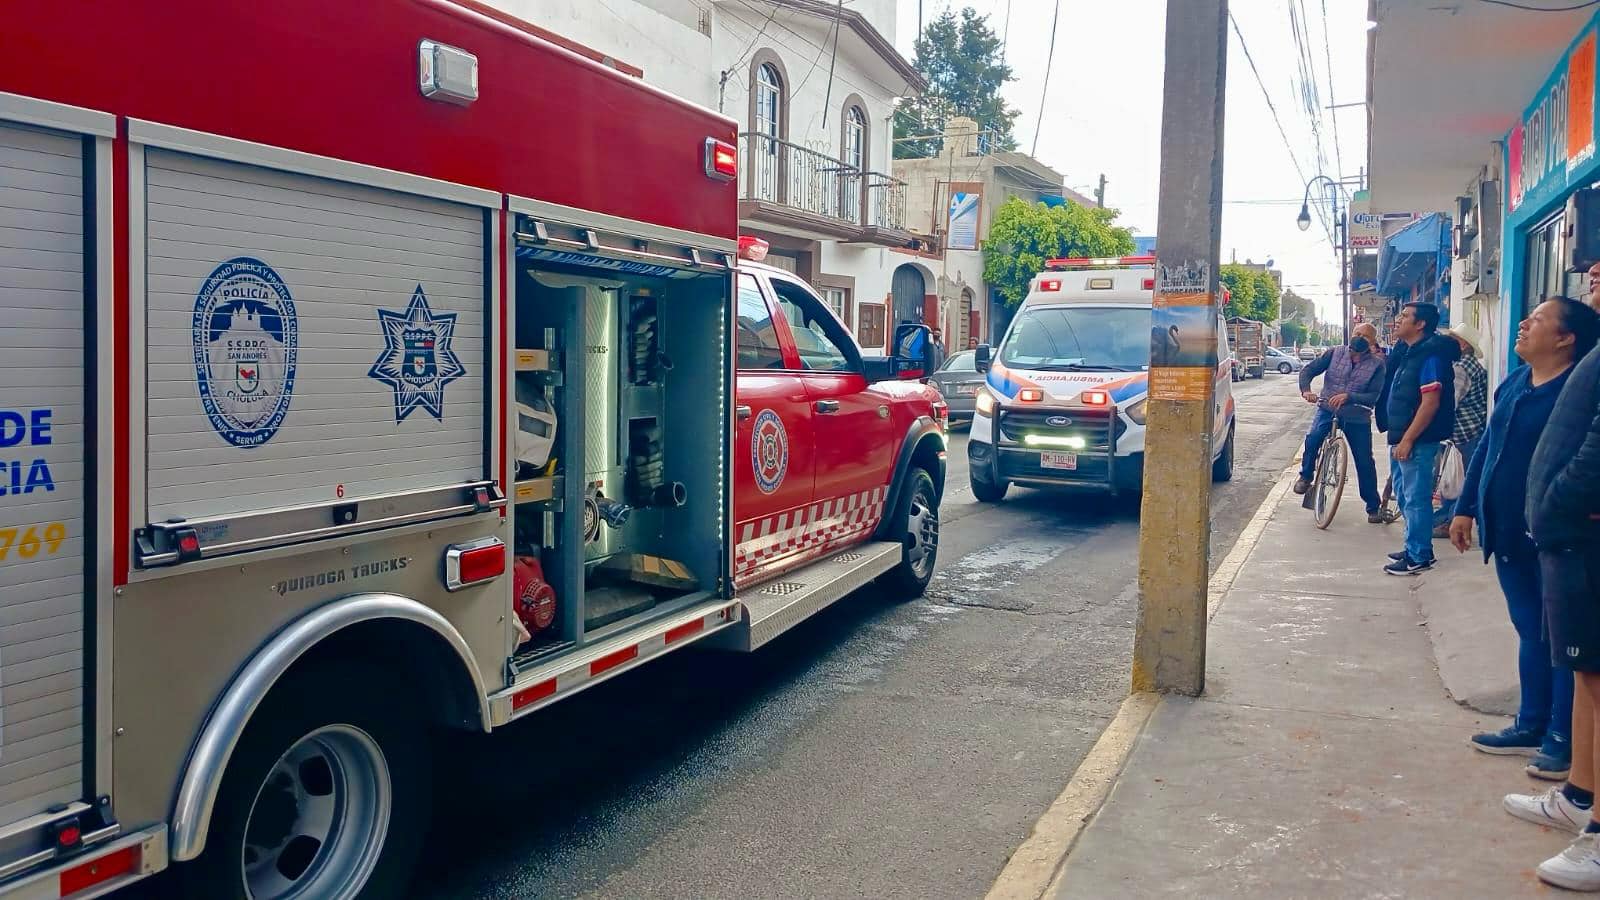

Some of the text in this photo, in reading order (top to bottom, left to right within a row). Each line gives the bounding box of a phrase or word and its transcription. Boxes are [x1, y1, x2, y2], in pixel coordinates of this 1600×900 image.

[227, 352, 241, 360] SAN
[227, 389, 269, 403] CHOLULA
[235, 434, 264, 444] SERVIR
[336, 484, 345, 498] 6
[276, 557, 407, 596] QUIROGA TRUCKS
